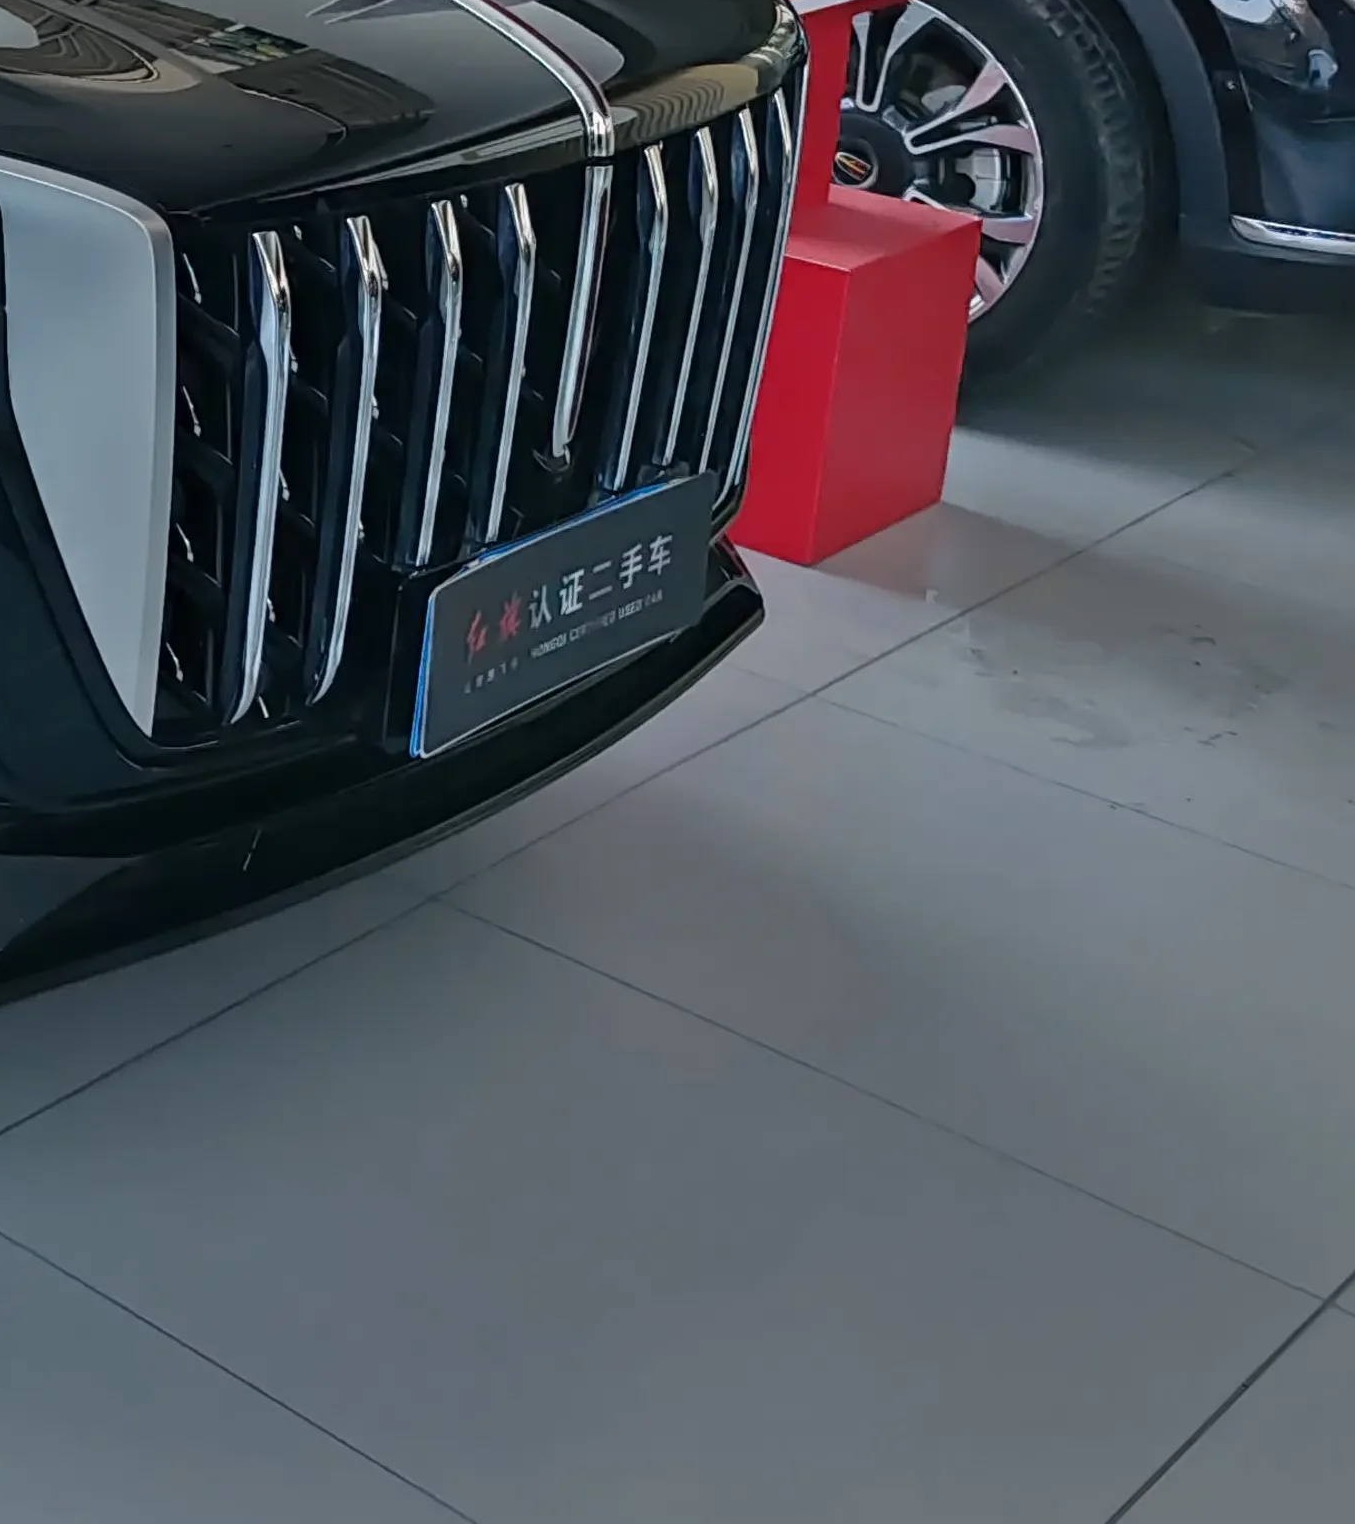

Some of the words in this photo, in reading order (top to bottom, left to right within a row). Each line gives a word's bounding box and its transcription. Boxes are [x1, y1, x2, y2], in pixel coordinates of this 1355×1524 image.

[528, 535, 673, 630] 认证二手车
